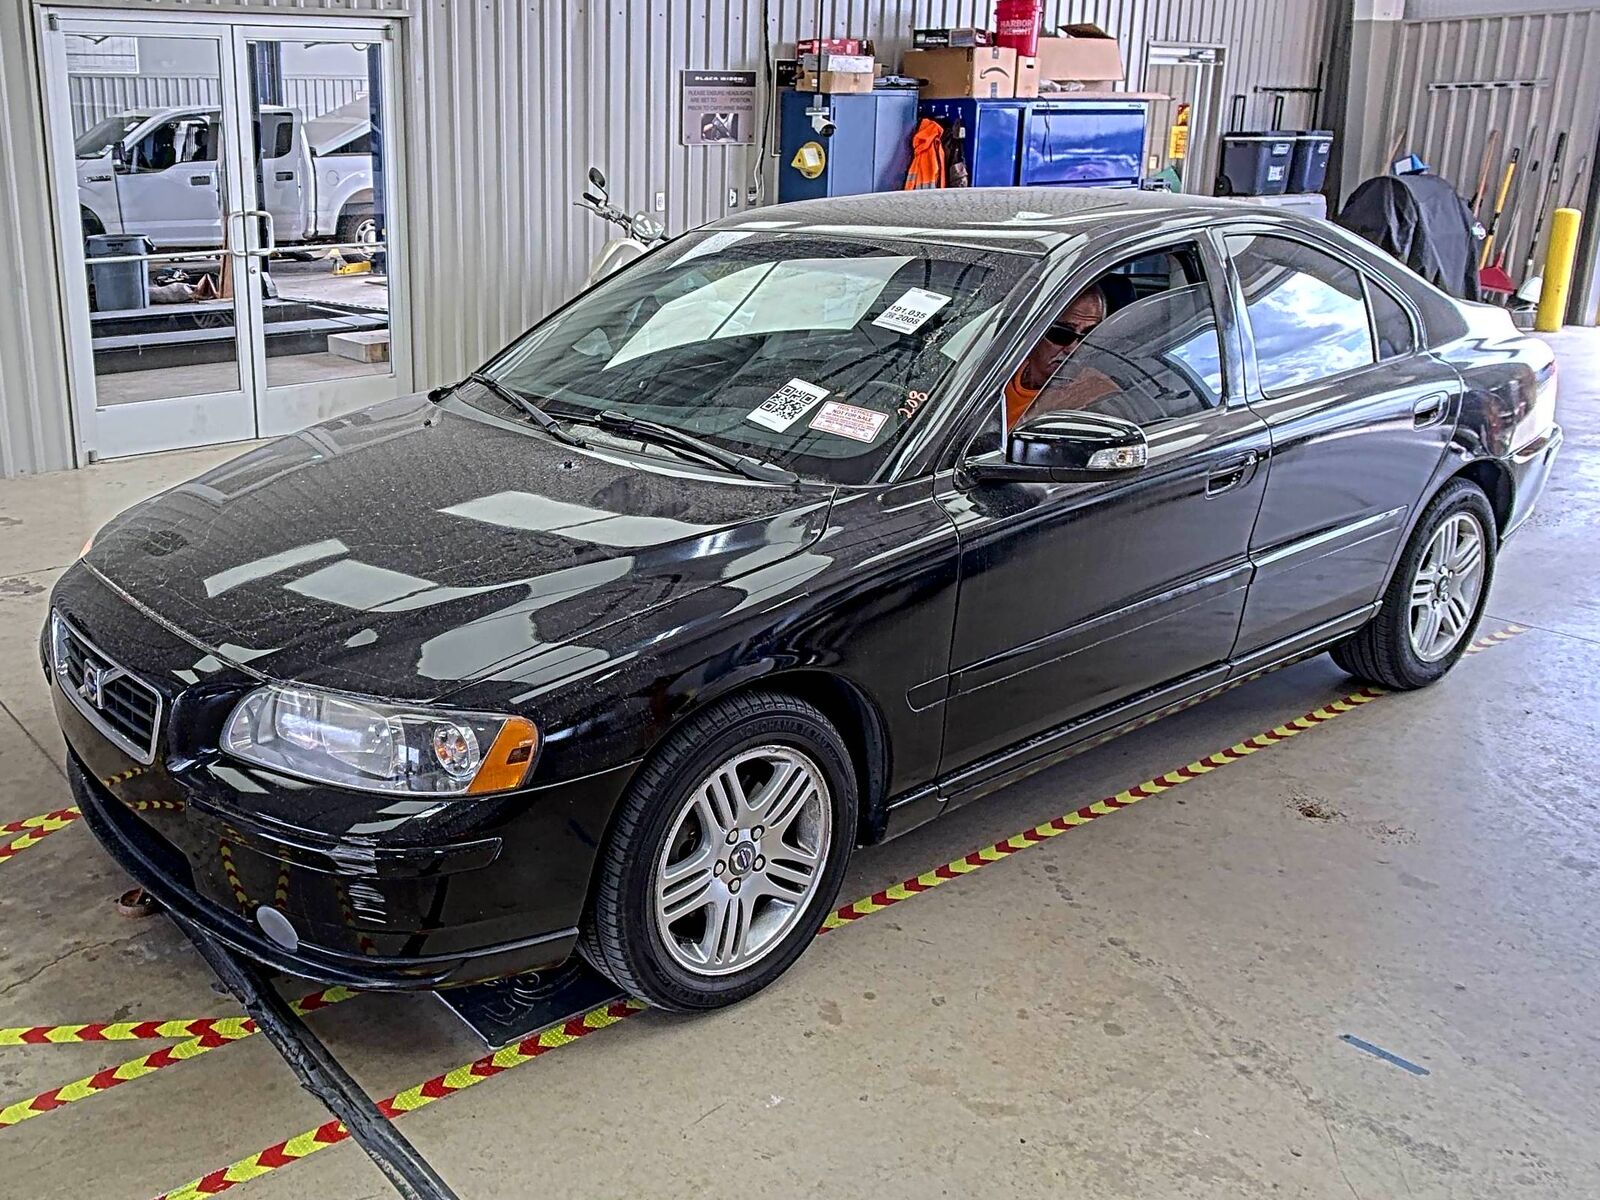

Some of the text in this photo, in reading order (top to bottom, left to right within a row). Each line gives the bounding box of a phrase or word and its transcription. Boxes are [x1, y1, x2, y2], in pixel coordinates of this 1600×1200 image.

[1000, 19, 1033, 28] HARBOR
[895, 314, 920, 325] 2008
[857, 414, 873, 422] SALE
[739, 718, 798, 737] YOKOHAMA
